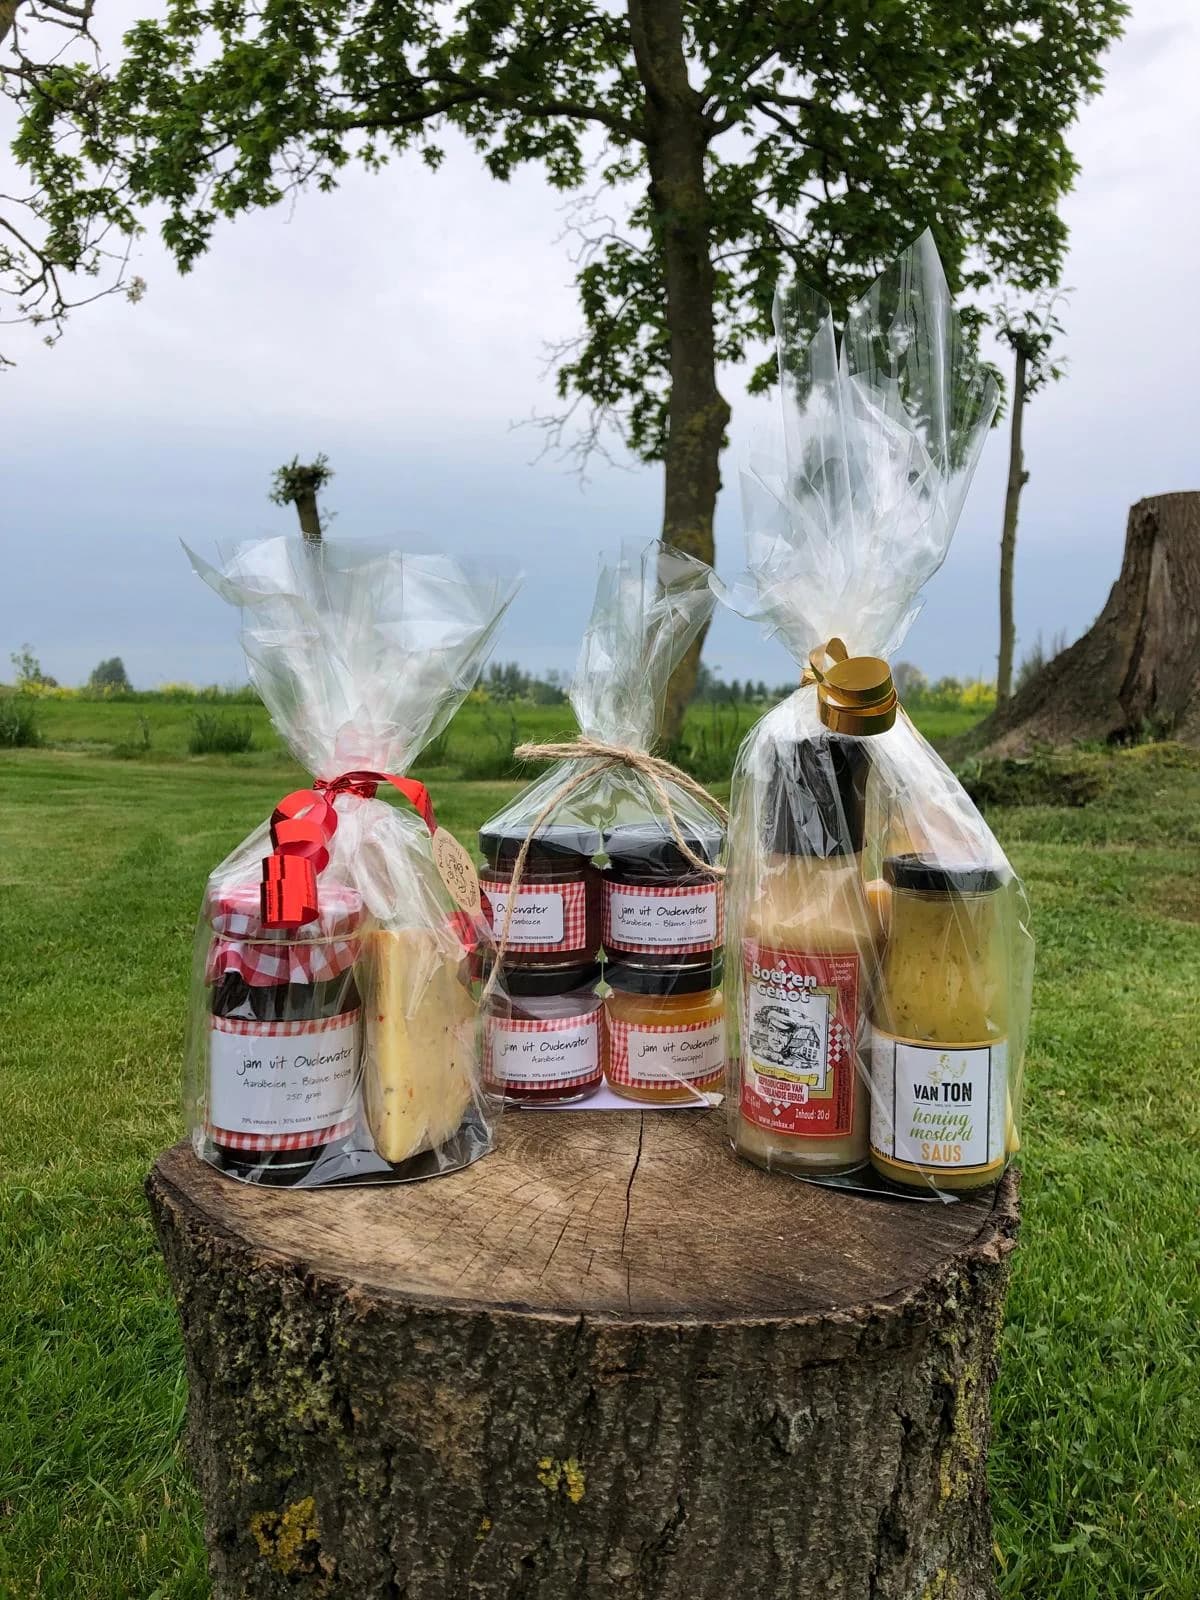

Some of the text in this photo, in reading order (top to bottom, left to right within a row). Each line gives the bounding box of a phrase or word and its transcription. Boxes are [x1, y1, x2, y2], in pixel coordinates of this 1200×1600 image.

[496, 903, 549, 915] Ouewater
[618, 904, 708, 919] jam uit Oudewater
[511, 917, 541, 926] rambozen
[752, 962, 817, 989] Boeren
[756, 981, 811, 1004] Genot
[522, 1042, 535, 1053] uit
[540, 1036, 590, 1053] Oudewater
[638, 1042, 658, 1057] jam
[662, 1042, 675, 1053] uit
[236, 1047, 353, 1076] jam uit Oudewater
[243, 1078, 287, 1089] Aardbeien
[792, 1083, 803, 1093] VAN
[913, 1082, 972, 1102] VAN TON
[795, 1109, 816, 1119] Inhoud:
[817, 1109, 824, 1119] 20
[912, 1107, 969, 1127] honing
[910, 1126, 973, 1141] mosterd
[922, 1143, 961, 1162] SAUS
